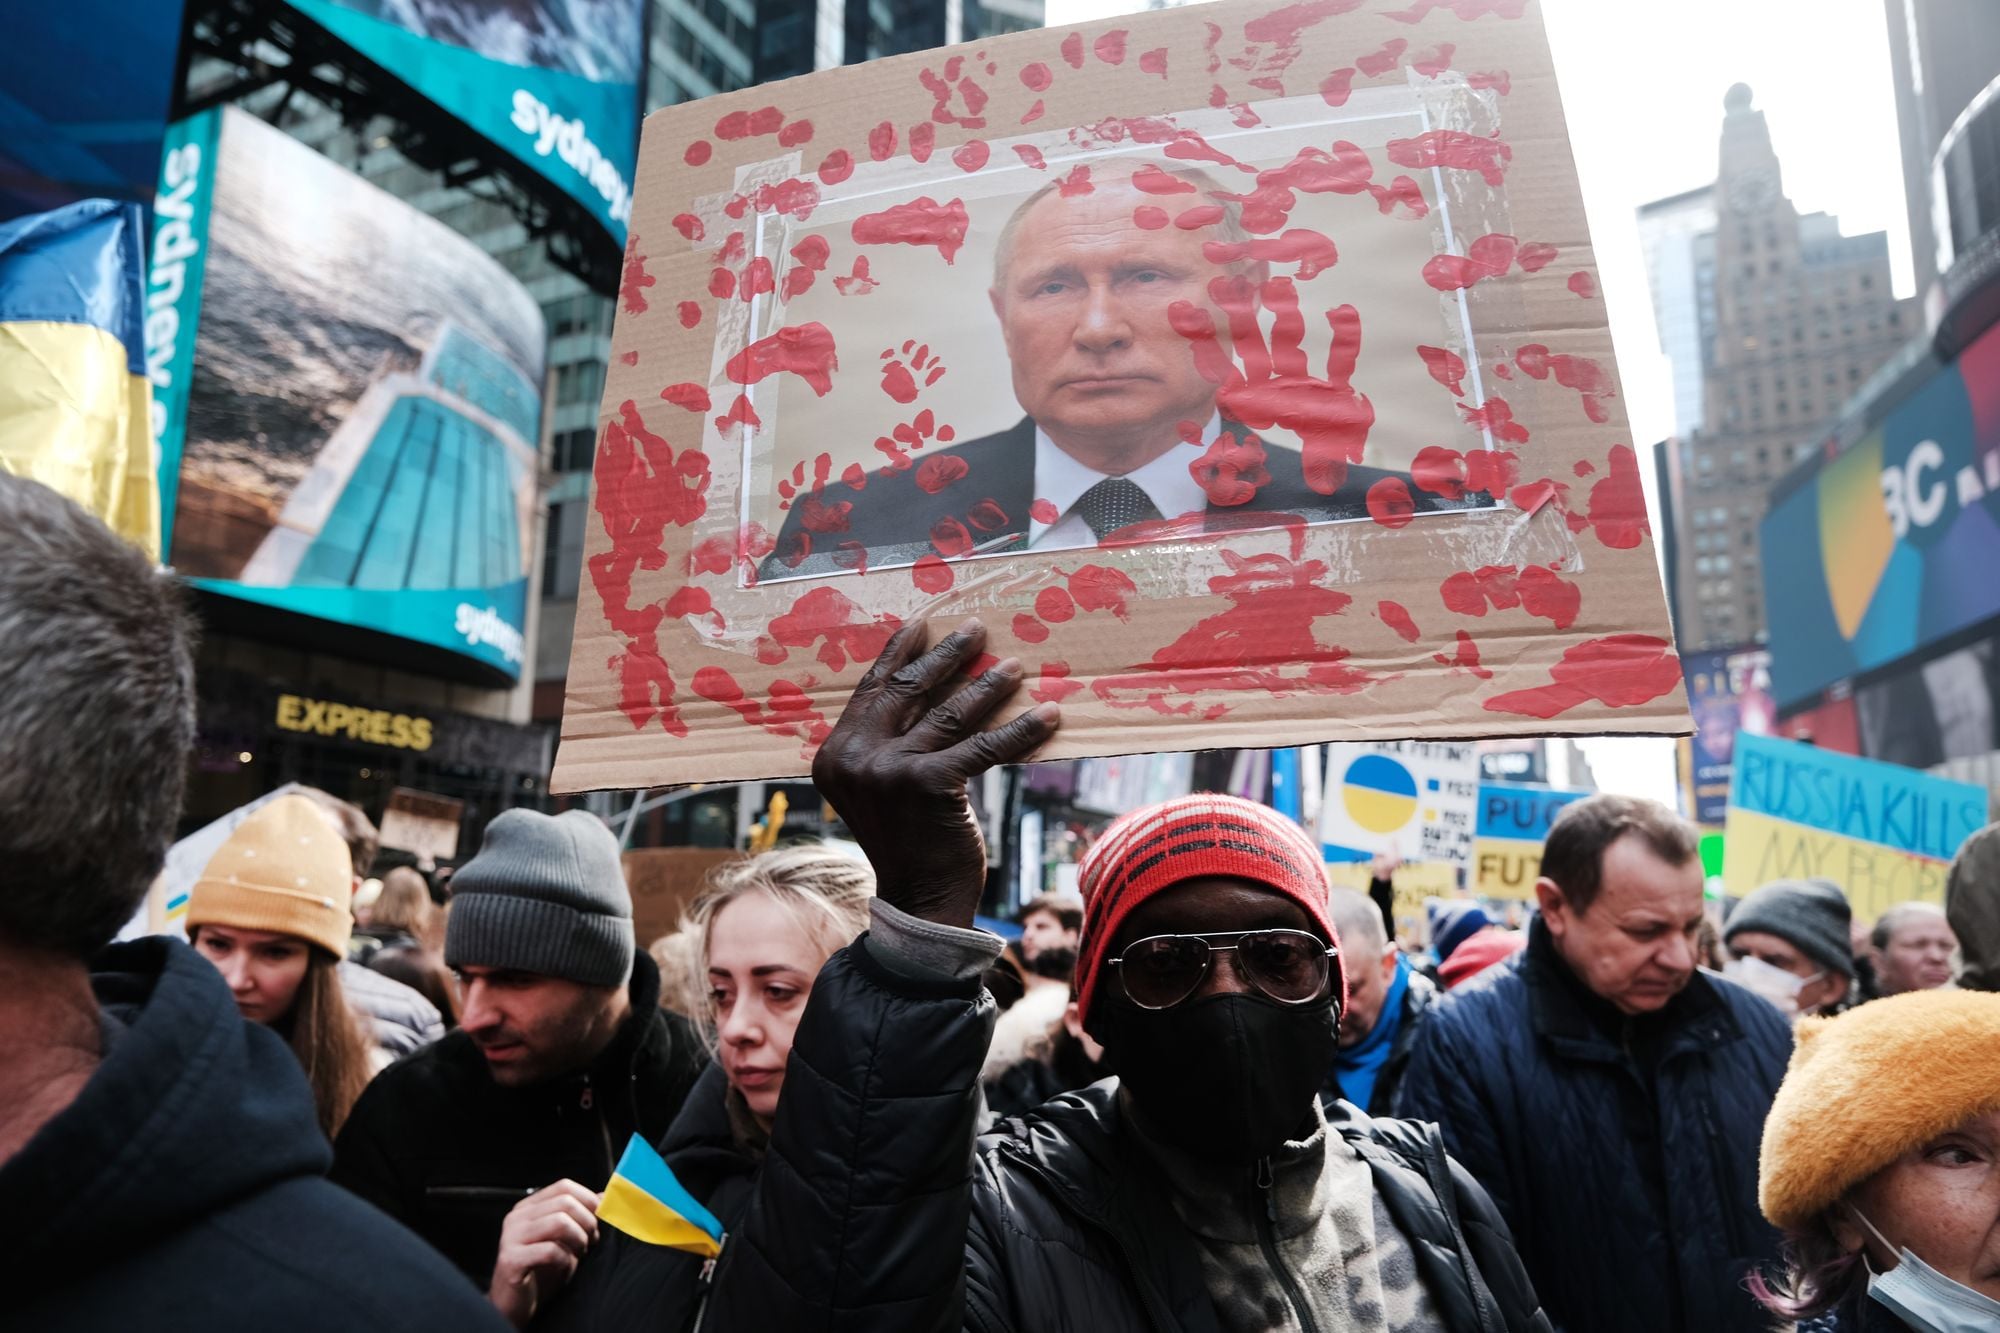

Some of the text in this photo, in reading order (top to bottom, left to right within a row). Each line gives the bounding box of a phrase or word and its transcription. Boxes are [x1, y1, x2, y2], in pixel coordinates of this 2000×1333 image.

[145, 142, 201, 472] sydney
[276, 693, 433, 751] EXPRESS
[1739, 751, 1984, 861] RUSSIA KILLS
[1754, 829, 1836, 882] MY
